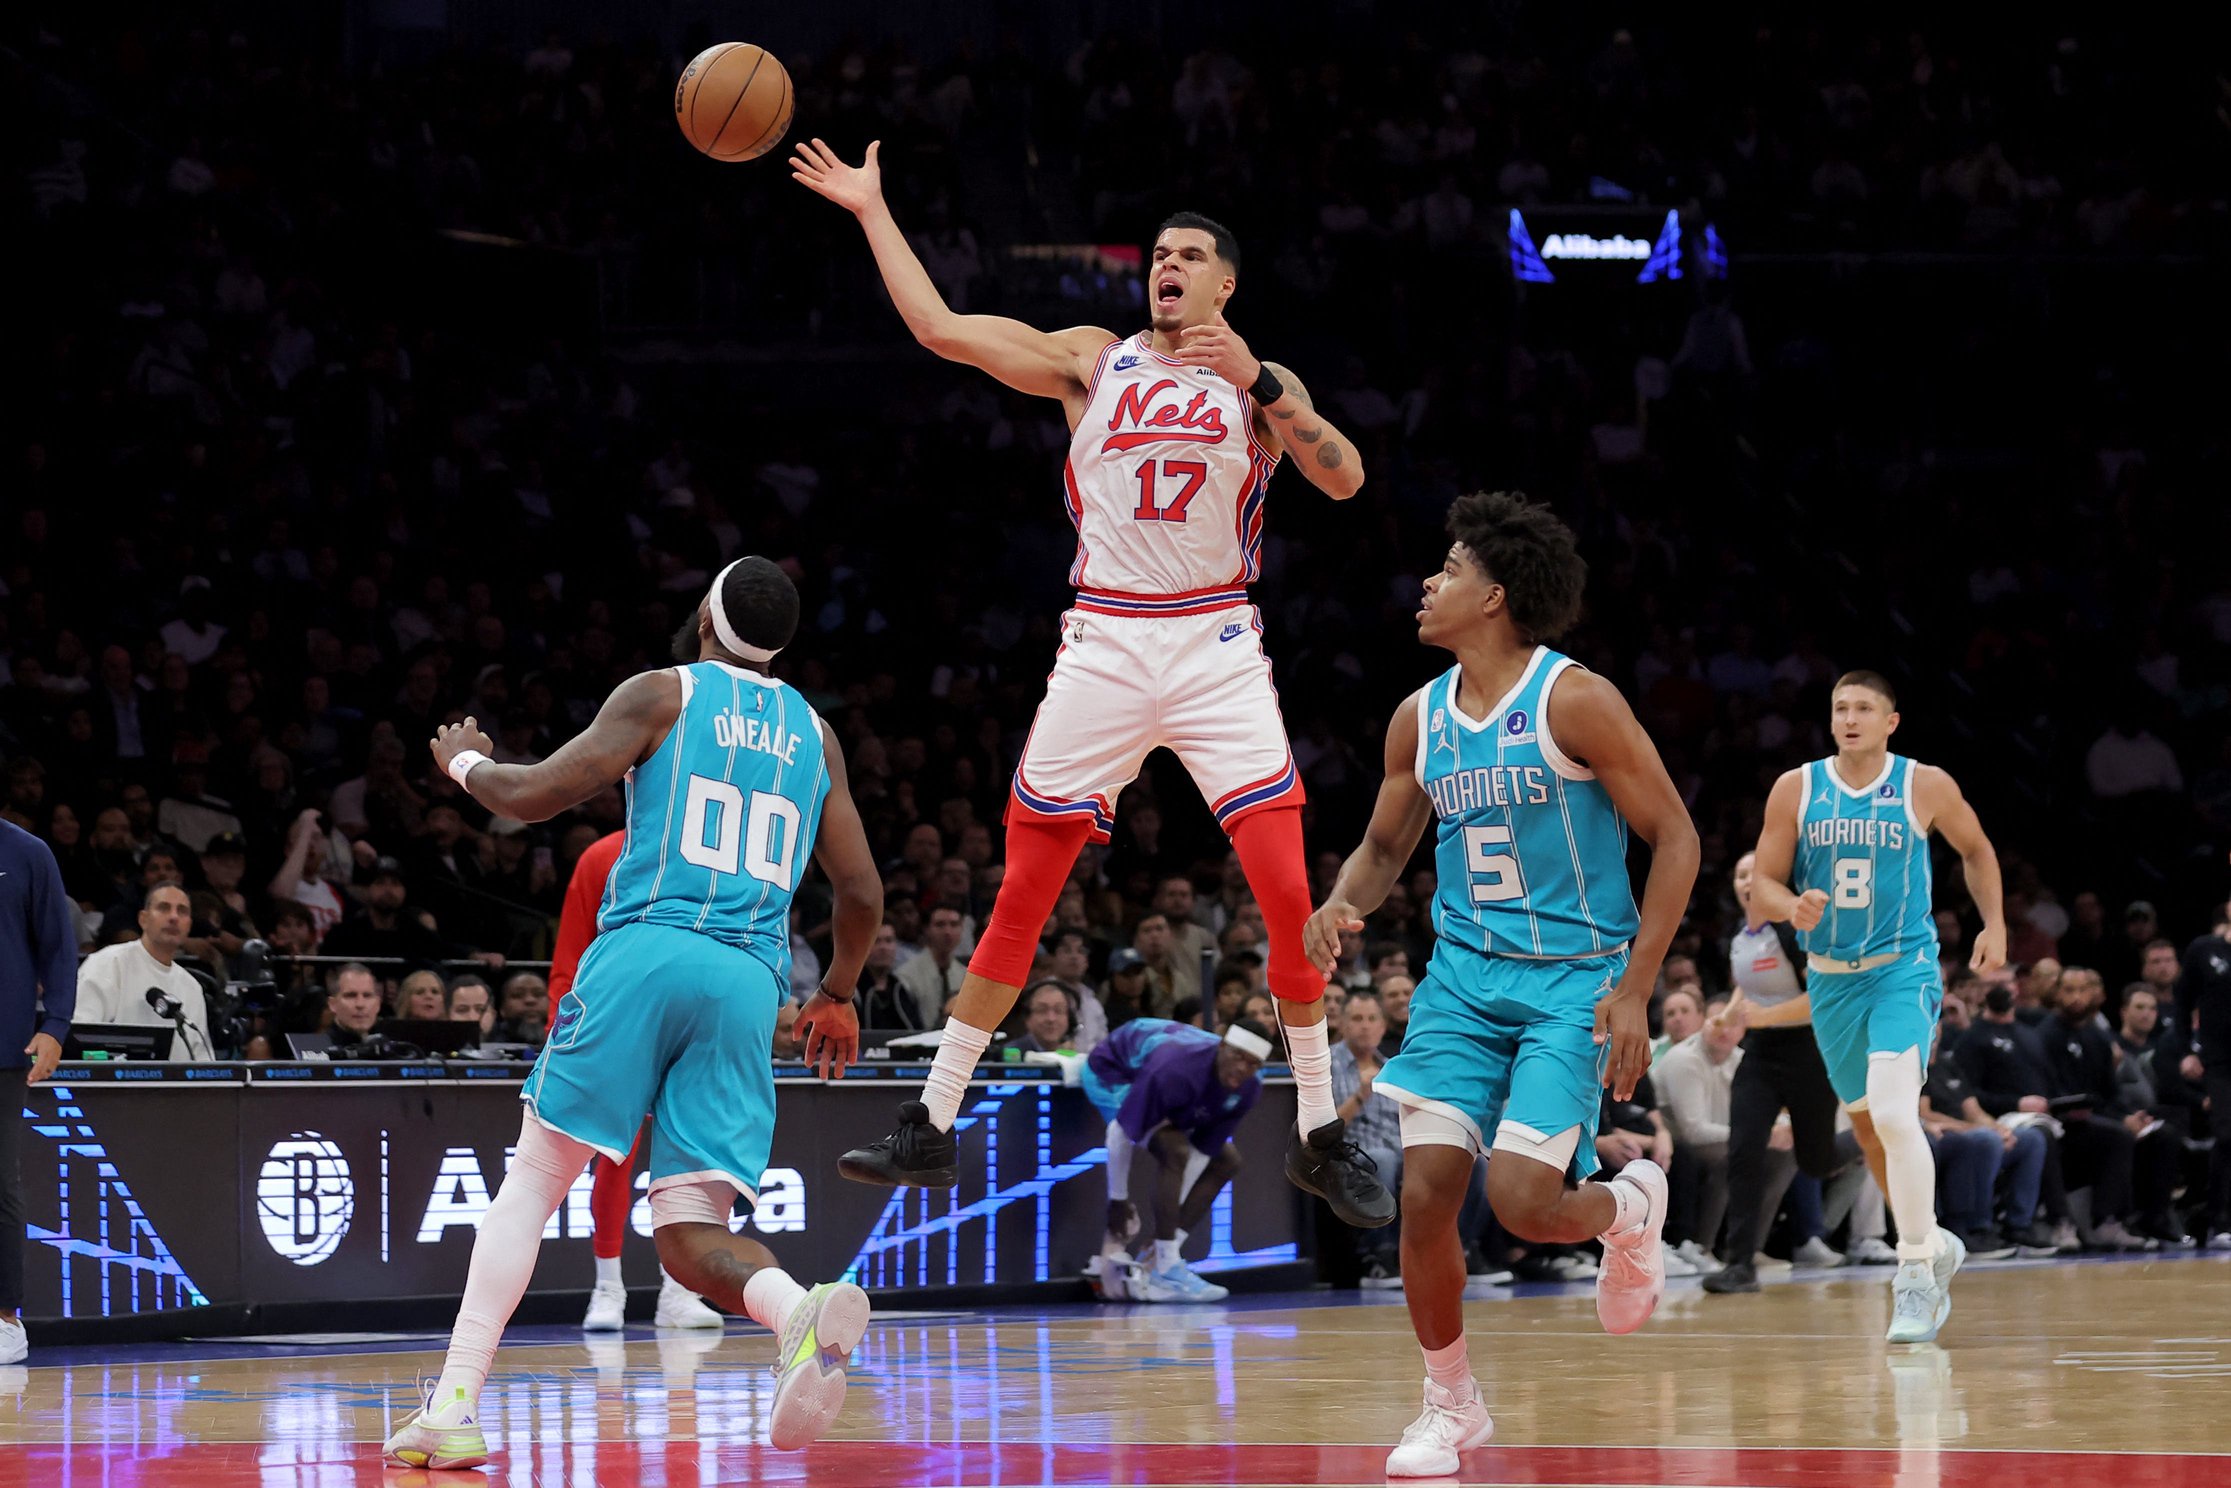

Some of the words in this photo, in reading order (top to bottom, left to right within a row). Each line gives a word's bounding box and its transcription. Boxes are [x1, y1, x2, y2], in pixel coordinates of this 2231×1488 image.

[1119, 355, 1139, 365] NIKE
[1105, 379, 1228, 445] Nets
[1134, 459, 1207, 522] 17
[1224, 624, 1242, 635] NIKE
[713, 707, 801, 767] O'NEALE
[1427, 766, 1550, 820] HORNETS
[679, 772, 802, 893] 00
[1807, 818, 1903, 849] HORNETS
[1463, 824, 1525, 902] 5
[1835, 858, 1873, 909] 8
